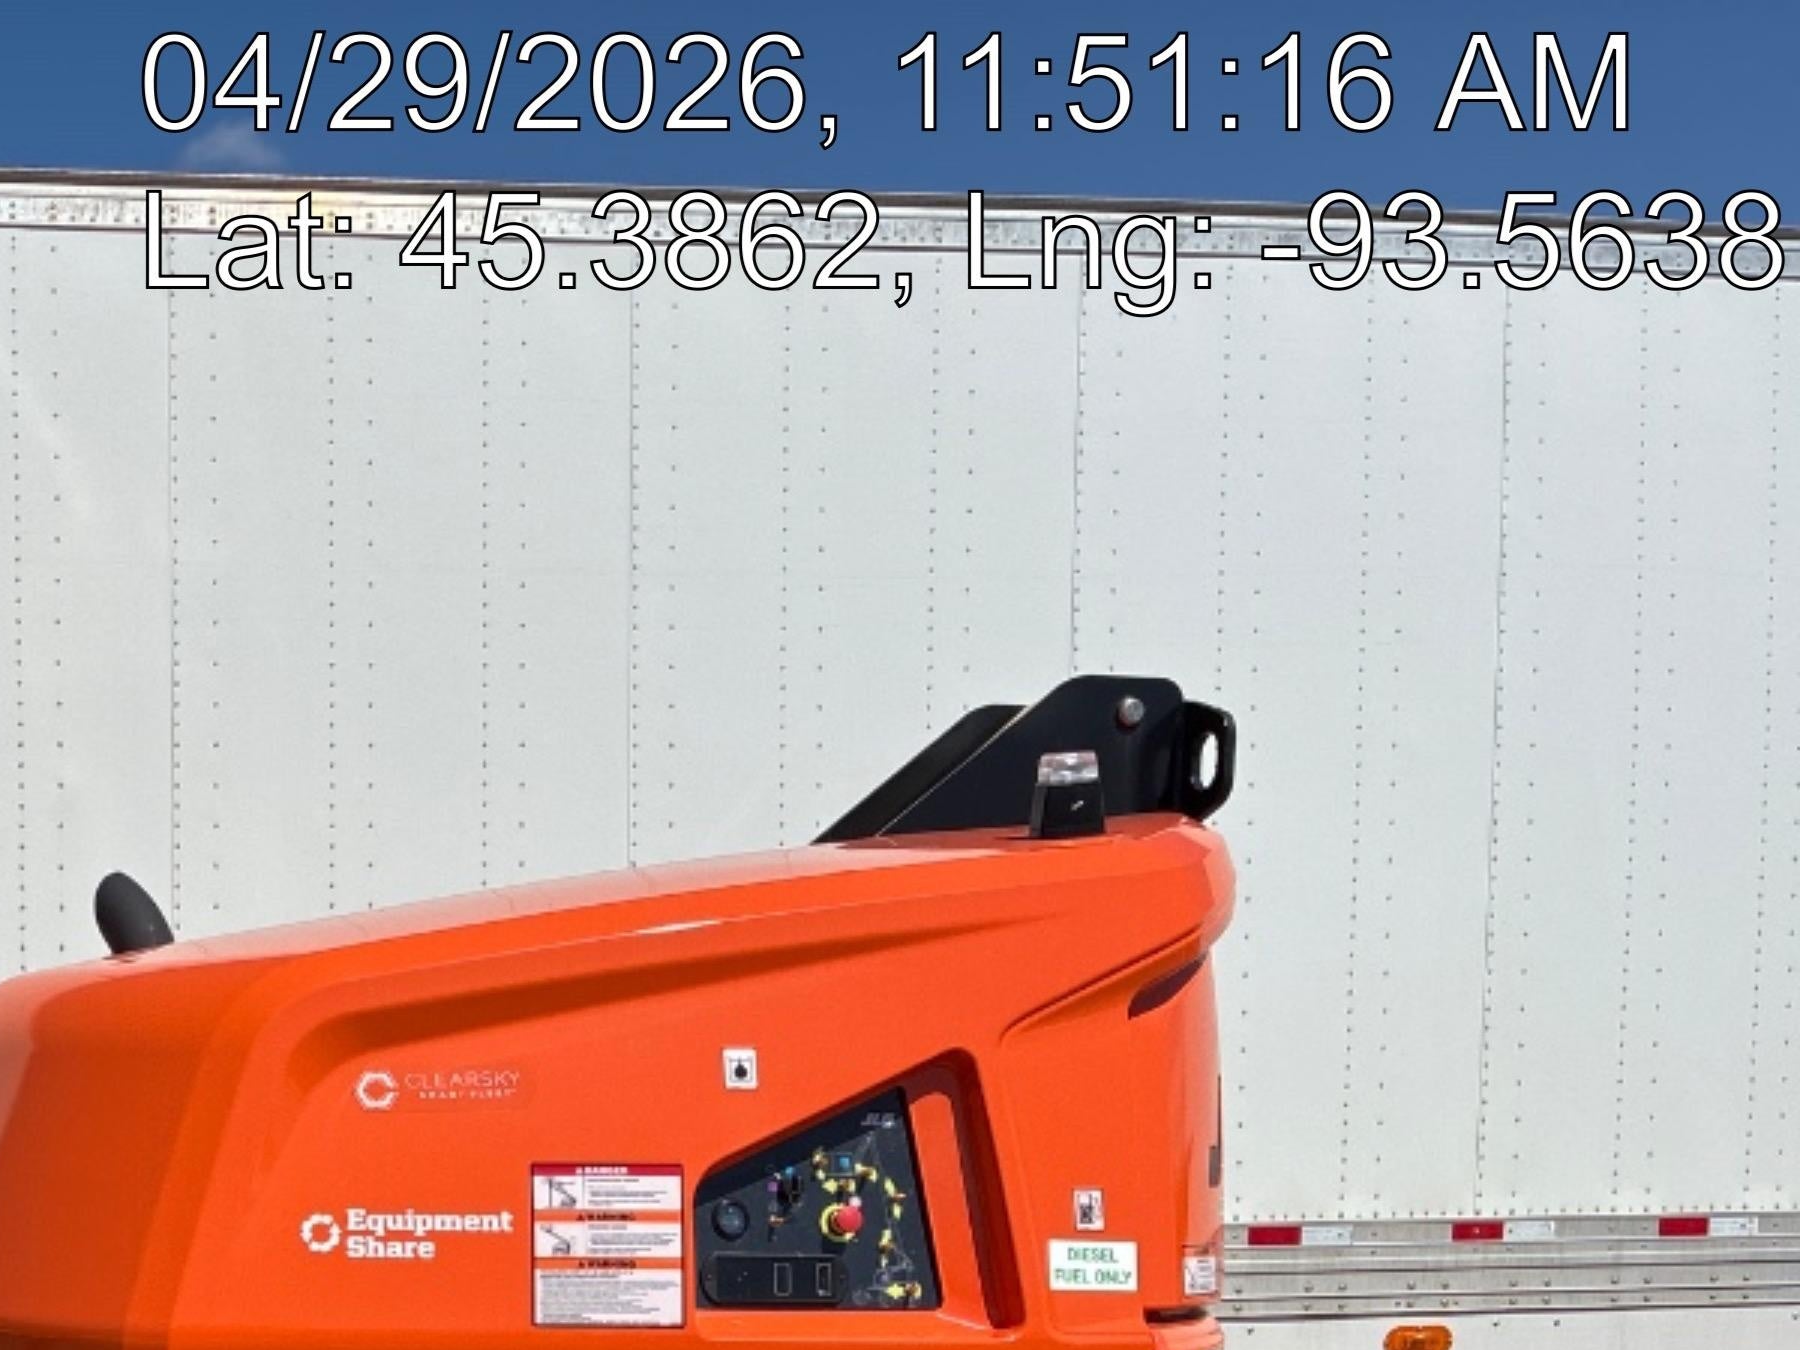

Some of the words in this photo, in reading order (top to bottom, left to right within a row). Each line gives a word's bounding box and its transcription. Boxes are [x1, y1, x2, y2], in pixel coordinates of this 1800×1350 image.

[346, 1208, 514, 1236] Equipment
[346, 1236, 436, 1258] Share
[1067, 1247, 1119, 1263] DIESEL
[1054, 1268, 1092, 1285] FUEL
[1094, 1268, 1132, 1285] ONLY
